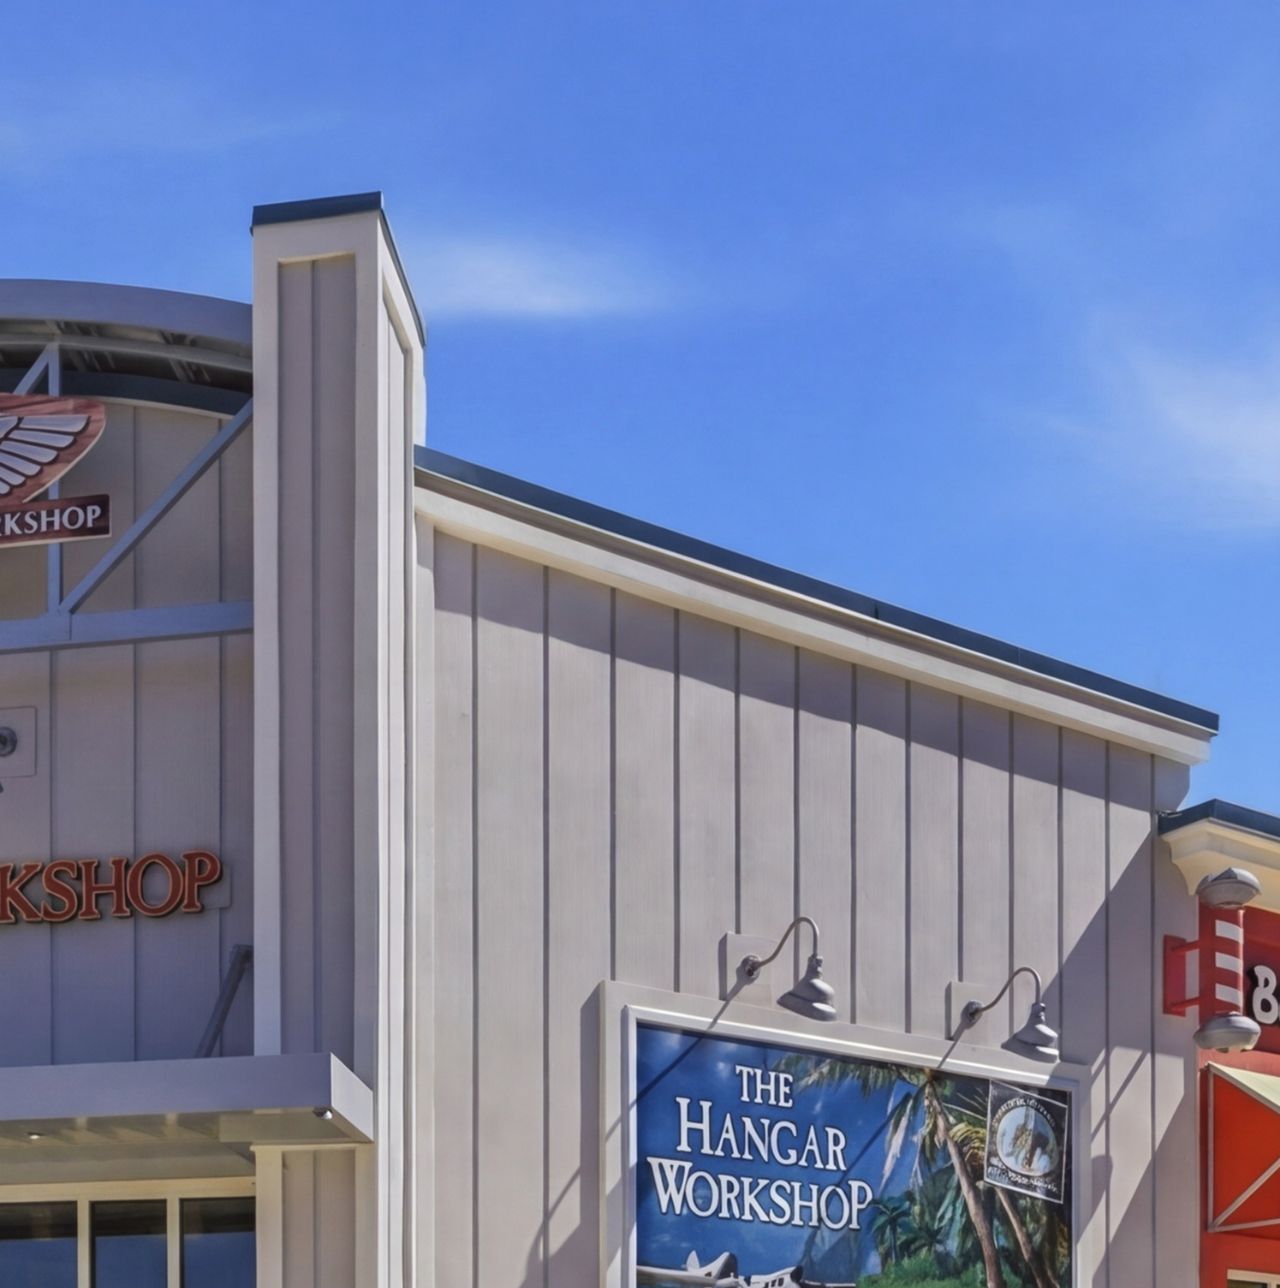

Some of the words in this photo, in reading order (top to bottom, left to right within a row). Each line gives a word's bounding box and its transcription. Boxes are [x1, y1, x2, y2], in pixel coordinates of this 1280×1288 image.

[734, 1064, 794, 1109] THE
[674, 1096, 848, 1172] HANGAR
[646, 1156, 873, 1231] WORKSHOP
